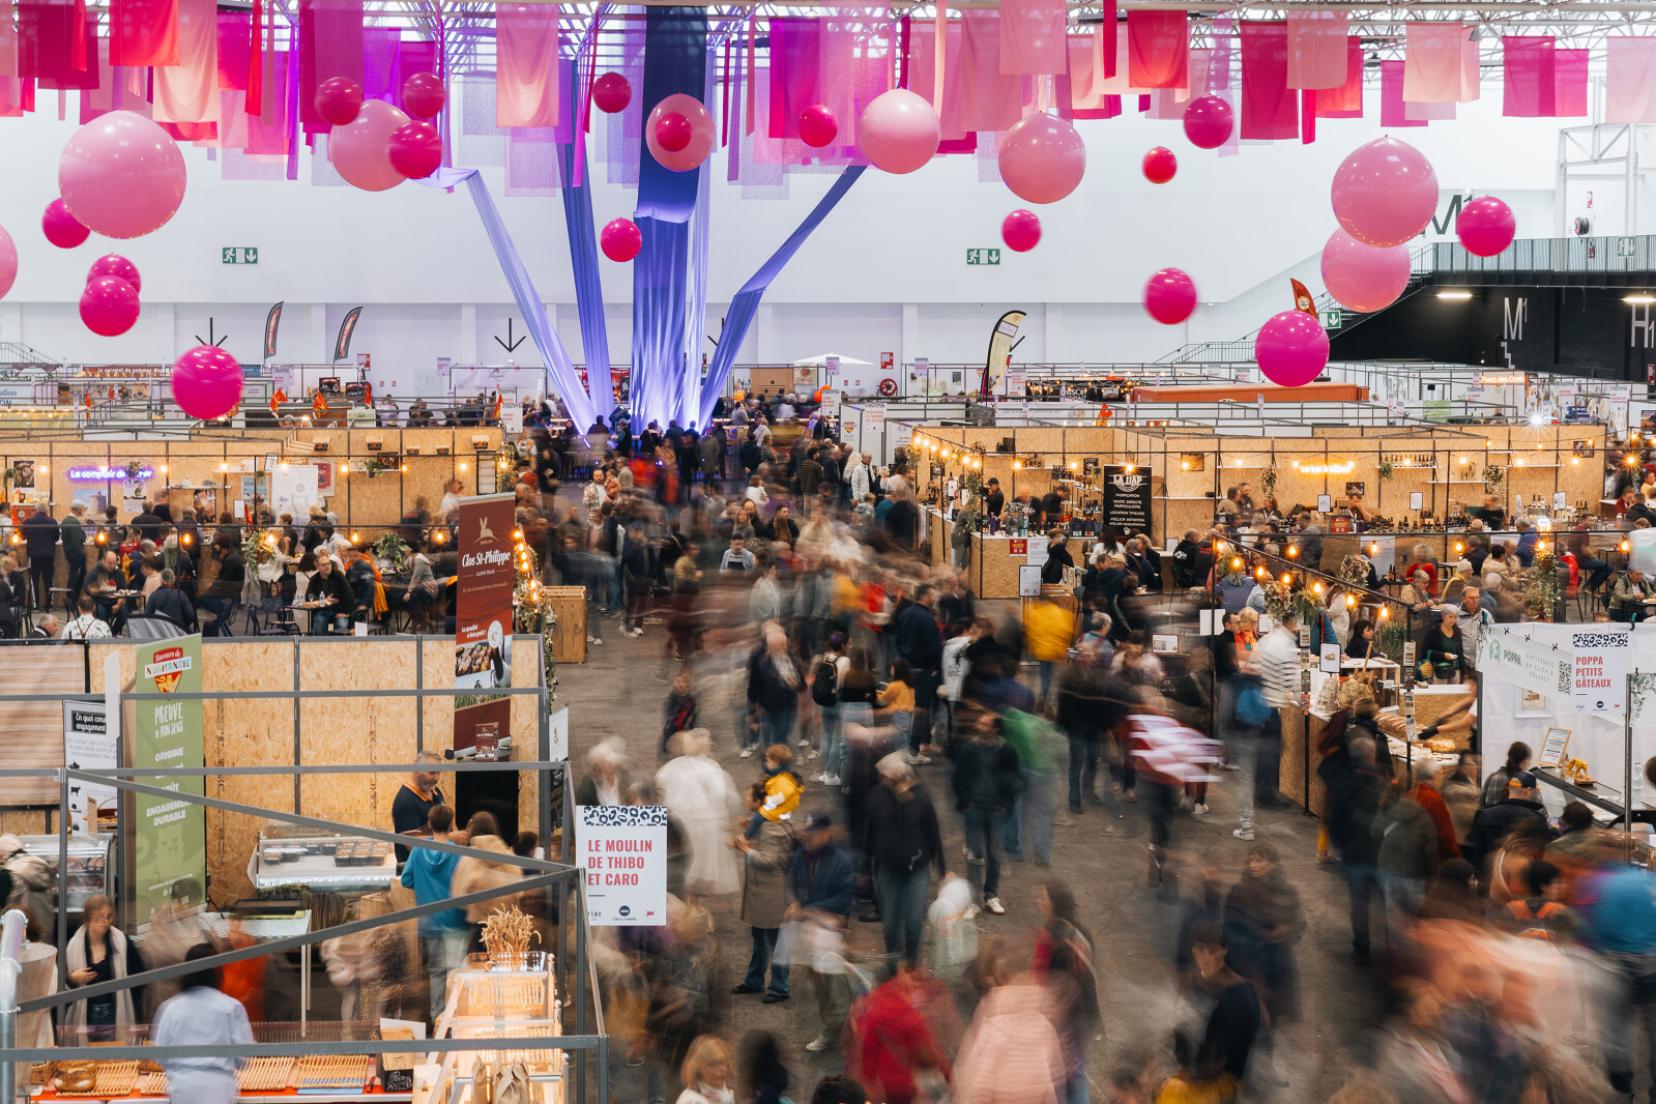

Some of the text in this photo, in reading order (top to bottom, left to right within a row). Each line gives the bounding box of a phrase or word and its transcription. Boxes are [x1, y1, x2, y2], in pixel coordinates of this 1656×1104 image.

[462, 549, 511, 568] Clos St-Philippe
[1576, 656, 1603, 665] POPPA
[1576, 668, 1603, 676] PETITS
[1576, 676, 1611, 688] GÂTEAUX
[154, 702, 183, 725] PREUVE
[154, 747, 184, 762] ORIGINE
[154, 809, 186, 826] DURABLE
[588, 840, 652, 852] LE MOULIN
[588, 857, 644, 869] DE THIBO
[588, 873, 639, 886] ET CARO
